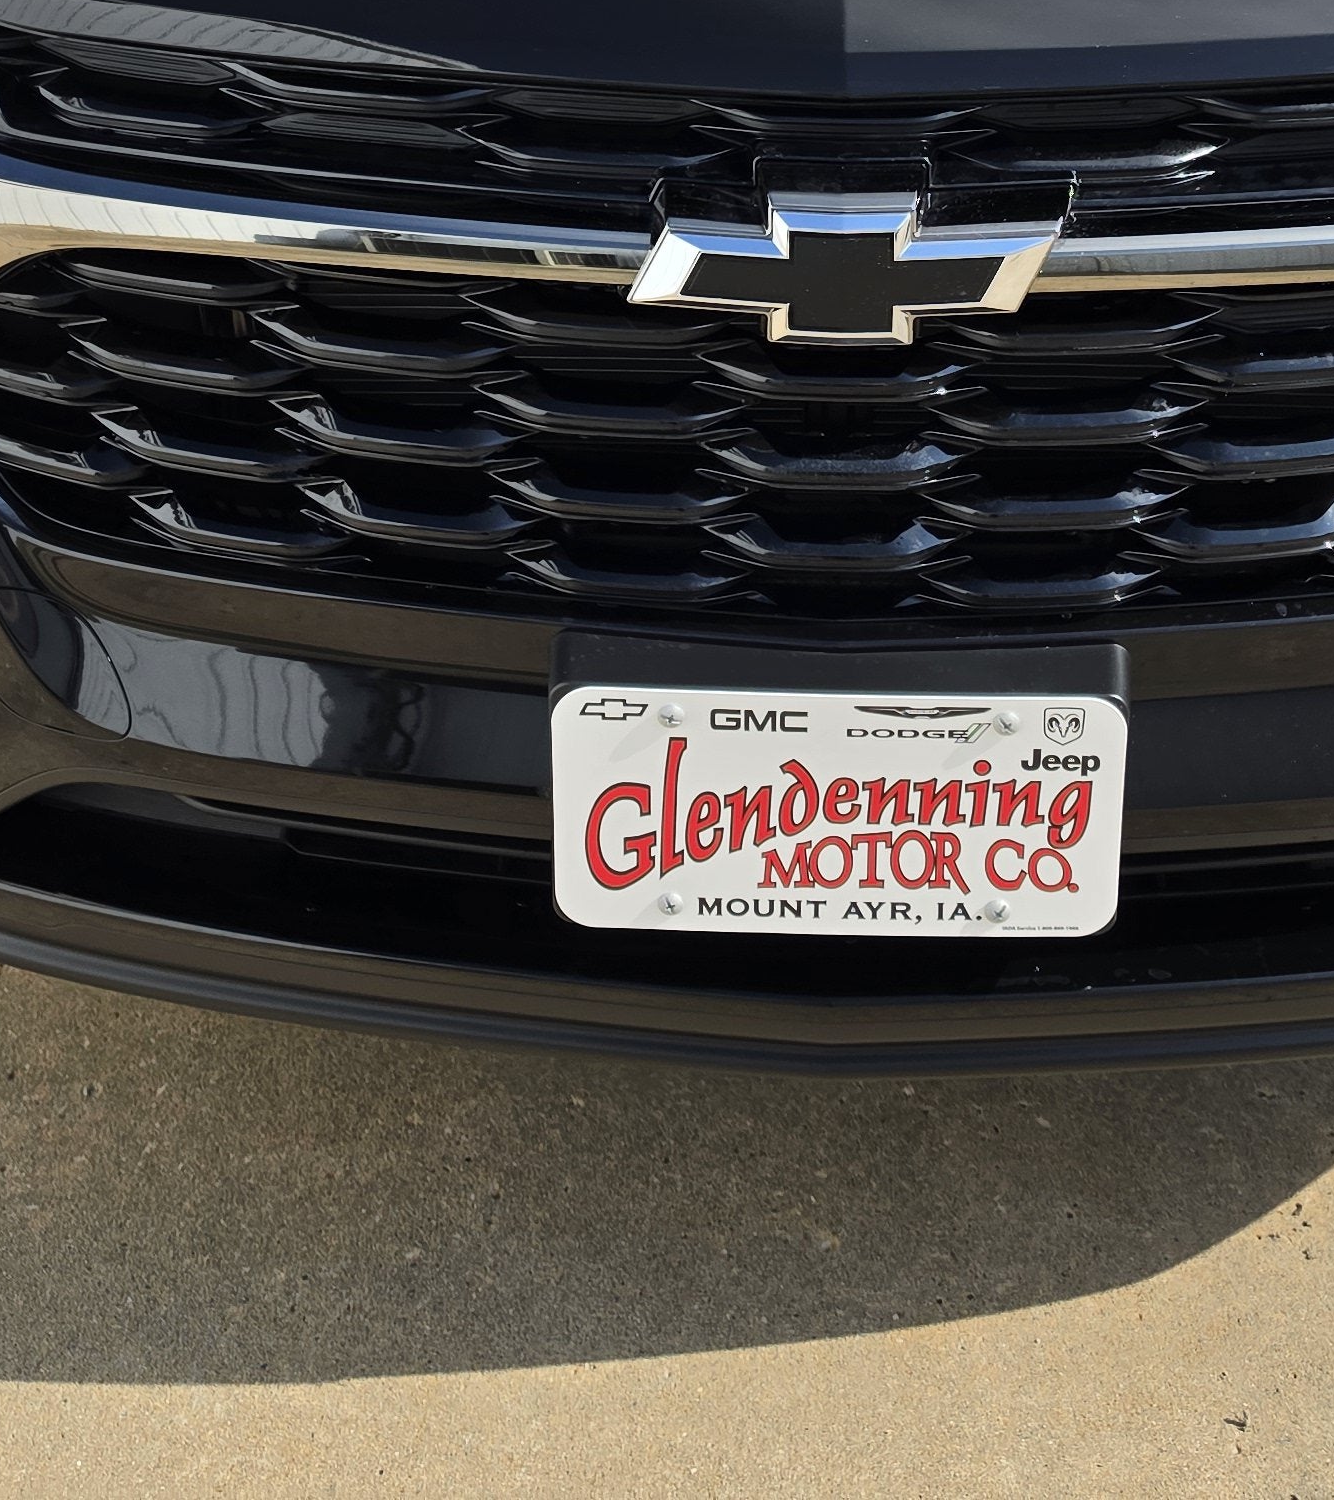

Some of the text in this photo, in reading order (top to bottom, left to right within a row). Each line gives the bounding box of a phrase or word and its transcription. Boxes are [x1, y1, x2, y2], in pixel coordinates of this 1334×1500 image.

[710, 708, 808, 732] GMC
[847, 728, 968, 739] DODGE
[1021, 749, 1101, 776] Jeep
[585, 737, 1093, 890] Glendenning
[757, 830, 1079, 895] MOTOR CO.
[698, 897, 983, 925] MOUNT AYR, IA.
